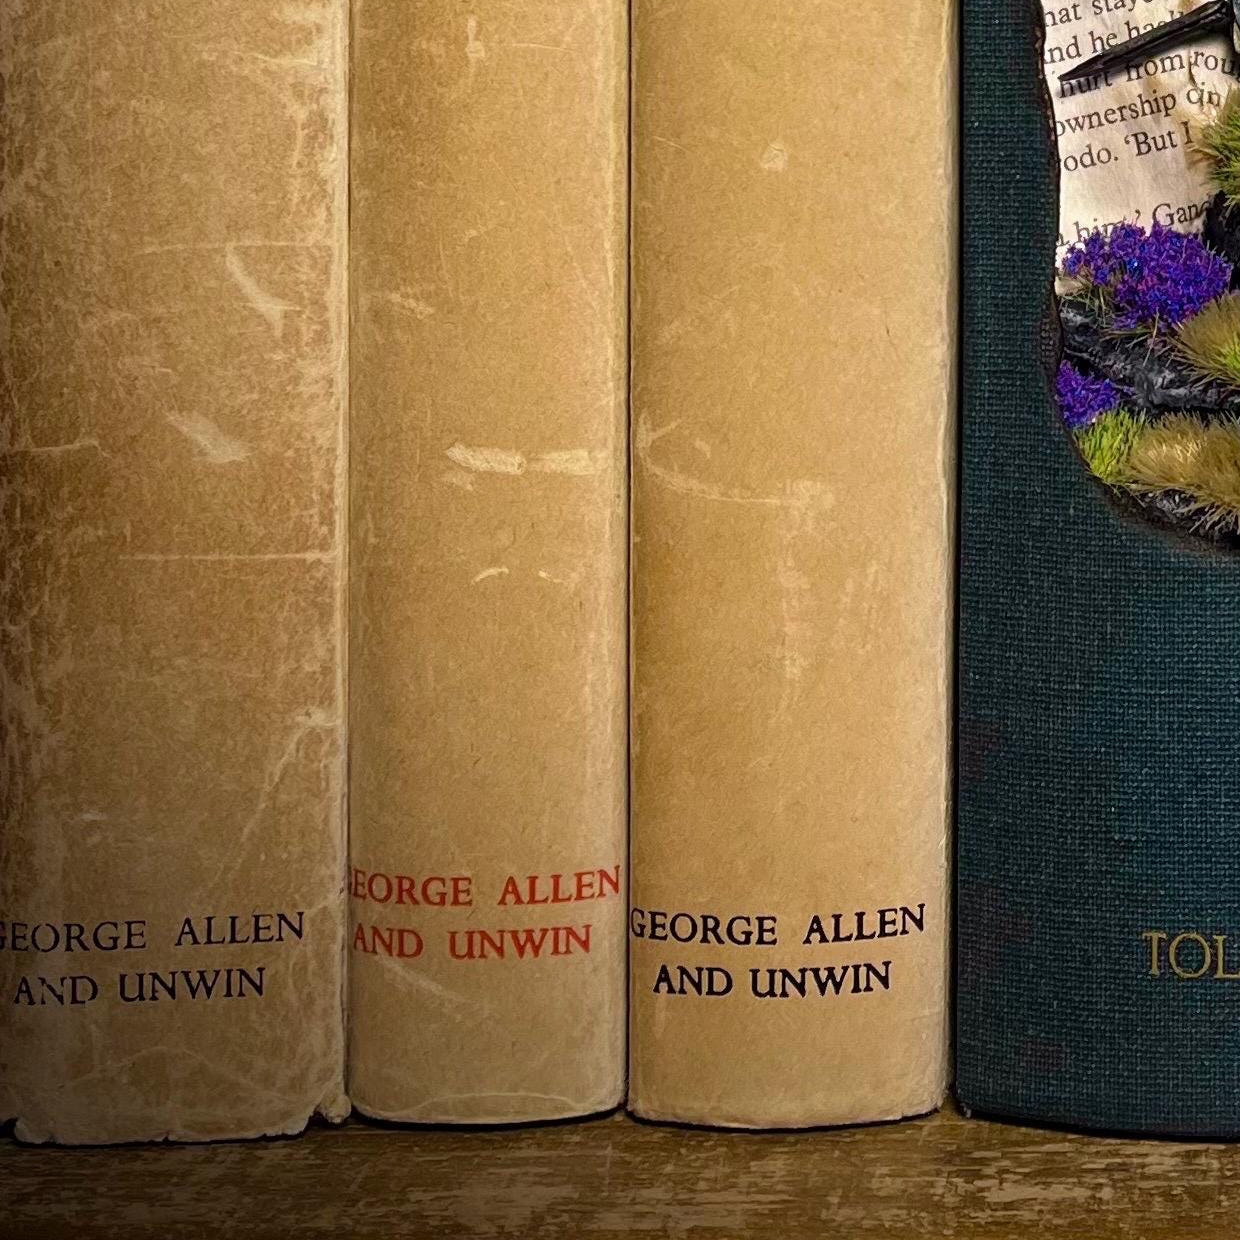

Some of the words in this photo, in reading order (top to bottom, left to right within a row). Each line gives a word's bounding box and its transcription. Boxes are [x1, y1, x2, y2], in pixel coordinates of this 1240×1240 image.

[1055, 89, 1177, 138] ownership
[350, 869, 472, 908] EORGE
[498, 864, 620, 906] ALLEN
[175, 911, 305, 947] ALLEN
[353, 922, 424, 959] AND
[449, 924, 592, 960] UNWIN
[630, 908, 778, 947] GEORGE
[802, 904, 926, 945] ALLEN
[13, 975, 99, 1006] AND
[119, 967, 266, 1003] UNWIN
[653, 965, 735, 997] AND
[750, 962, 892, 999] UNWIN
